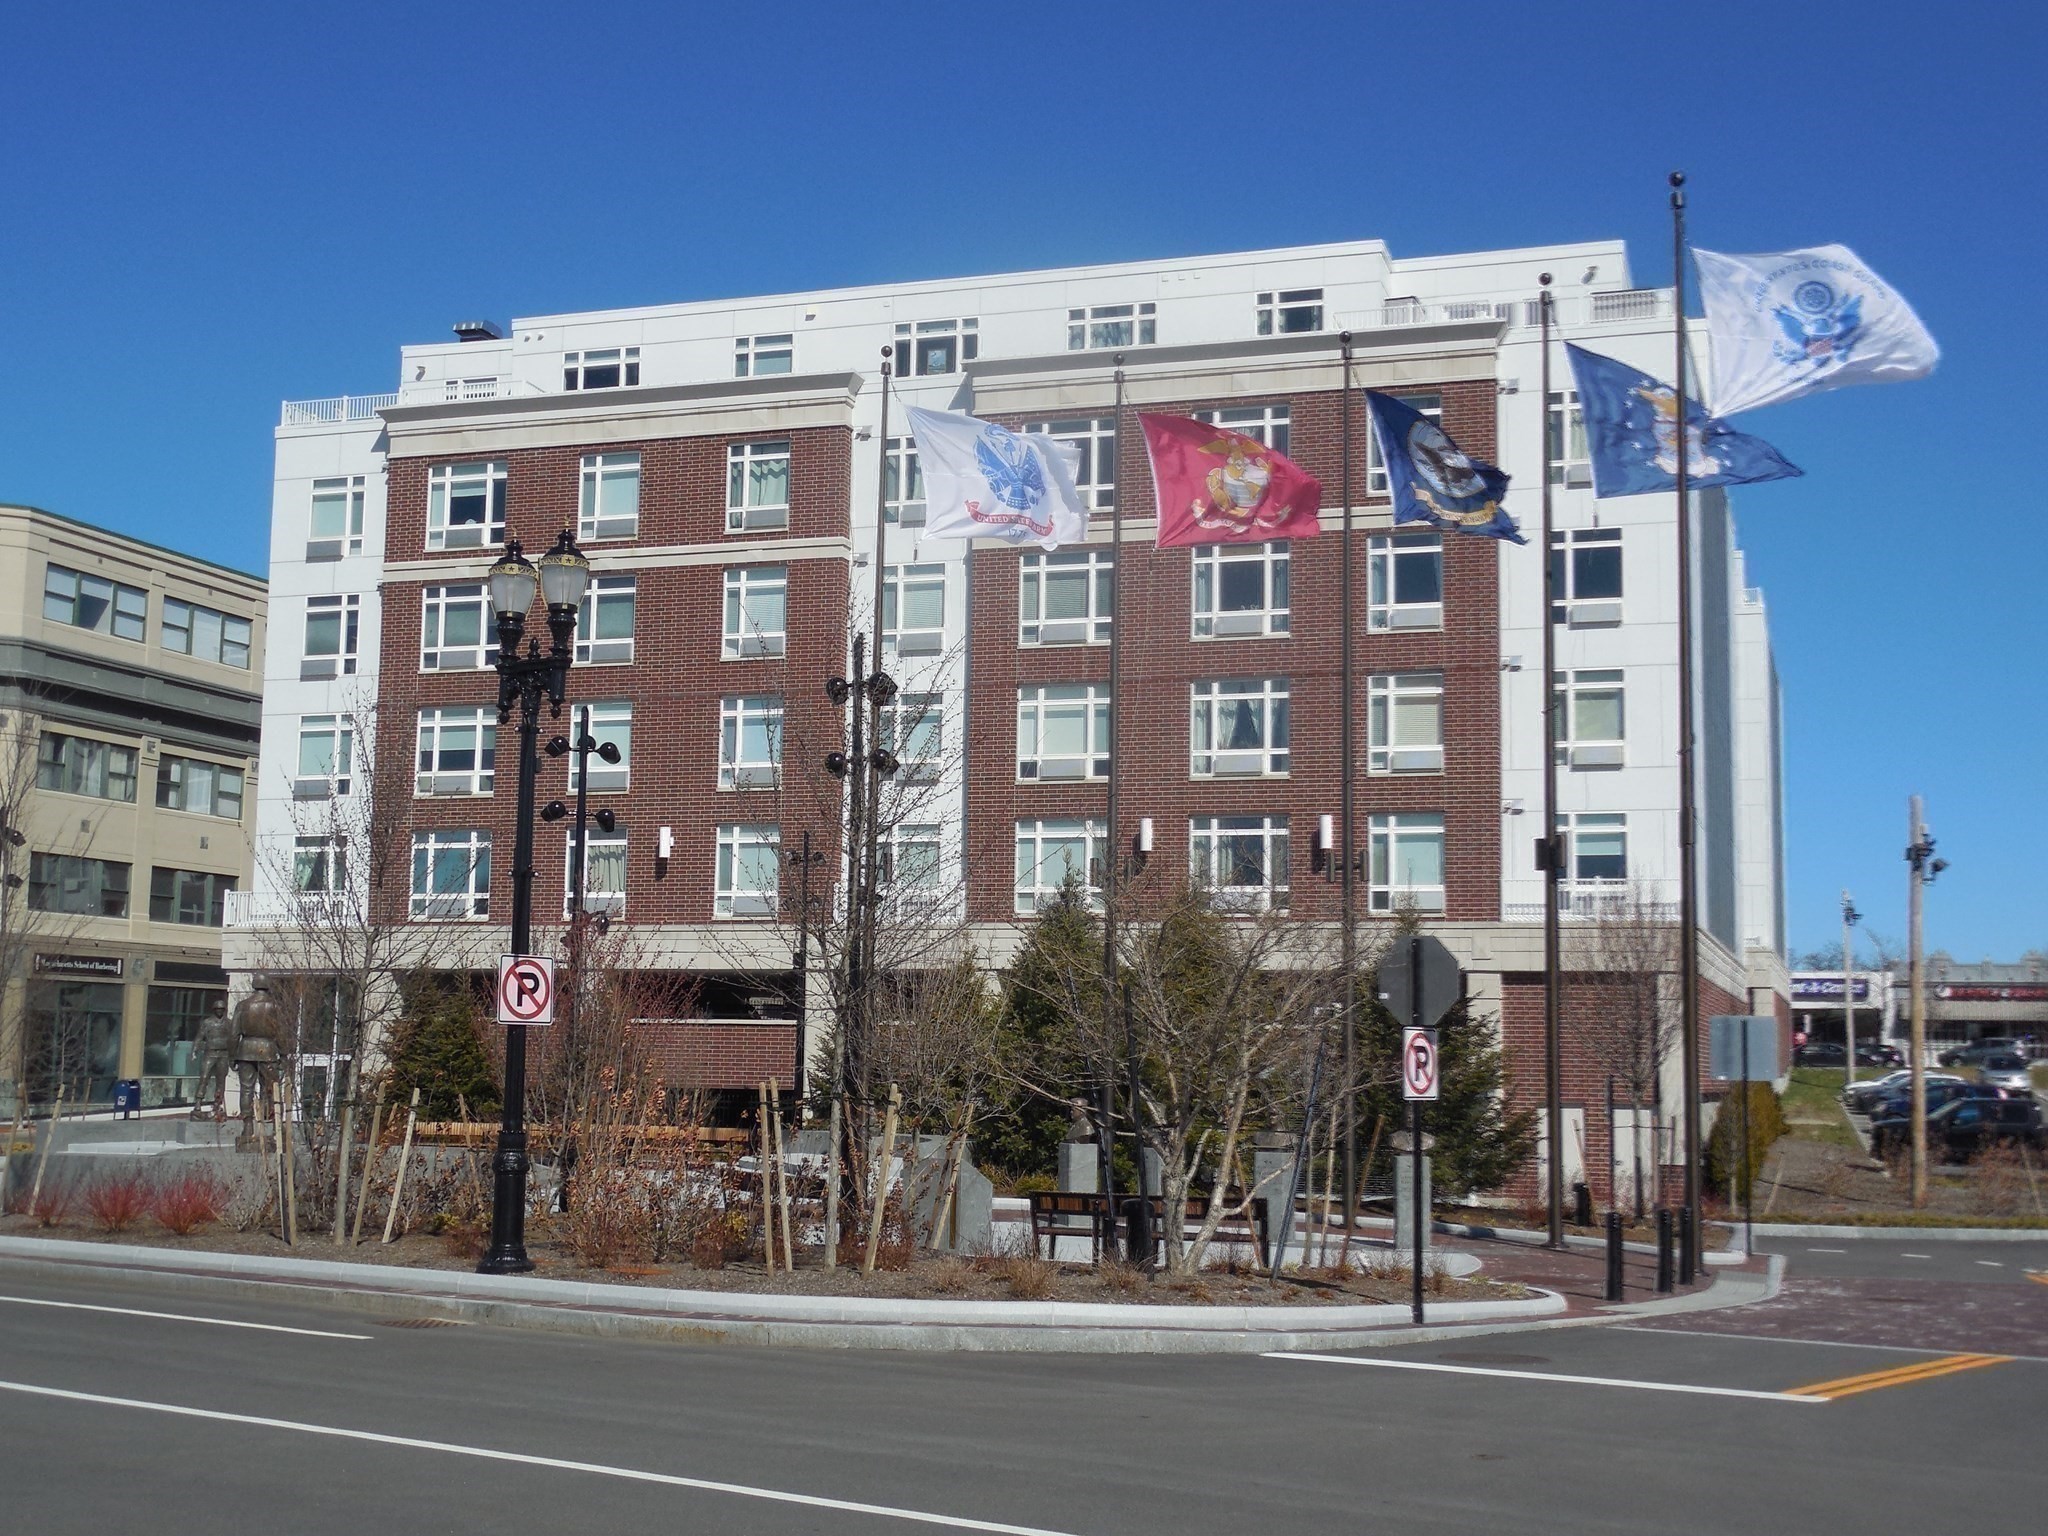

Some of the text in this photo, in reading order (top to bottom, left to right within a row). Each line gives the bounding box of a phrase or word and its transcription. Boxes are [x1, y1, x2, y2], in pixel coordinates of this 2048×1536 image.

[977, 514, 1009, 523] UNITED
[1032, 524, 1048, 535] ARM
[74, 960, 89, 969] School
[95, 961, 118, 973] Barbering
[516, 972, 540, 1007] P
[1413, 1046, 1428, 1081] P
